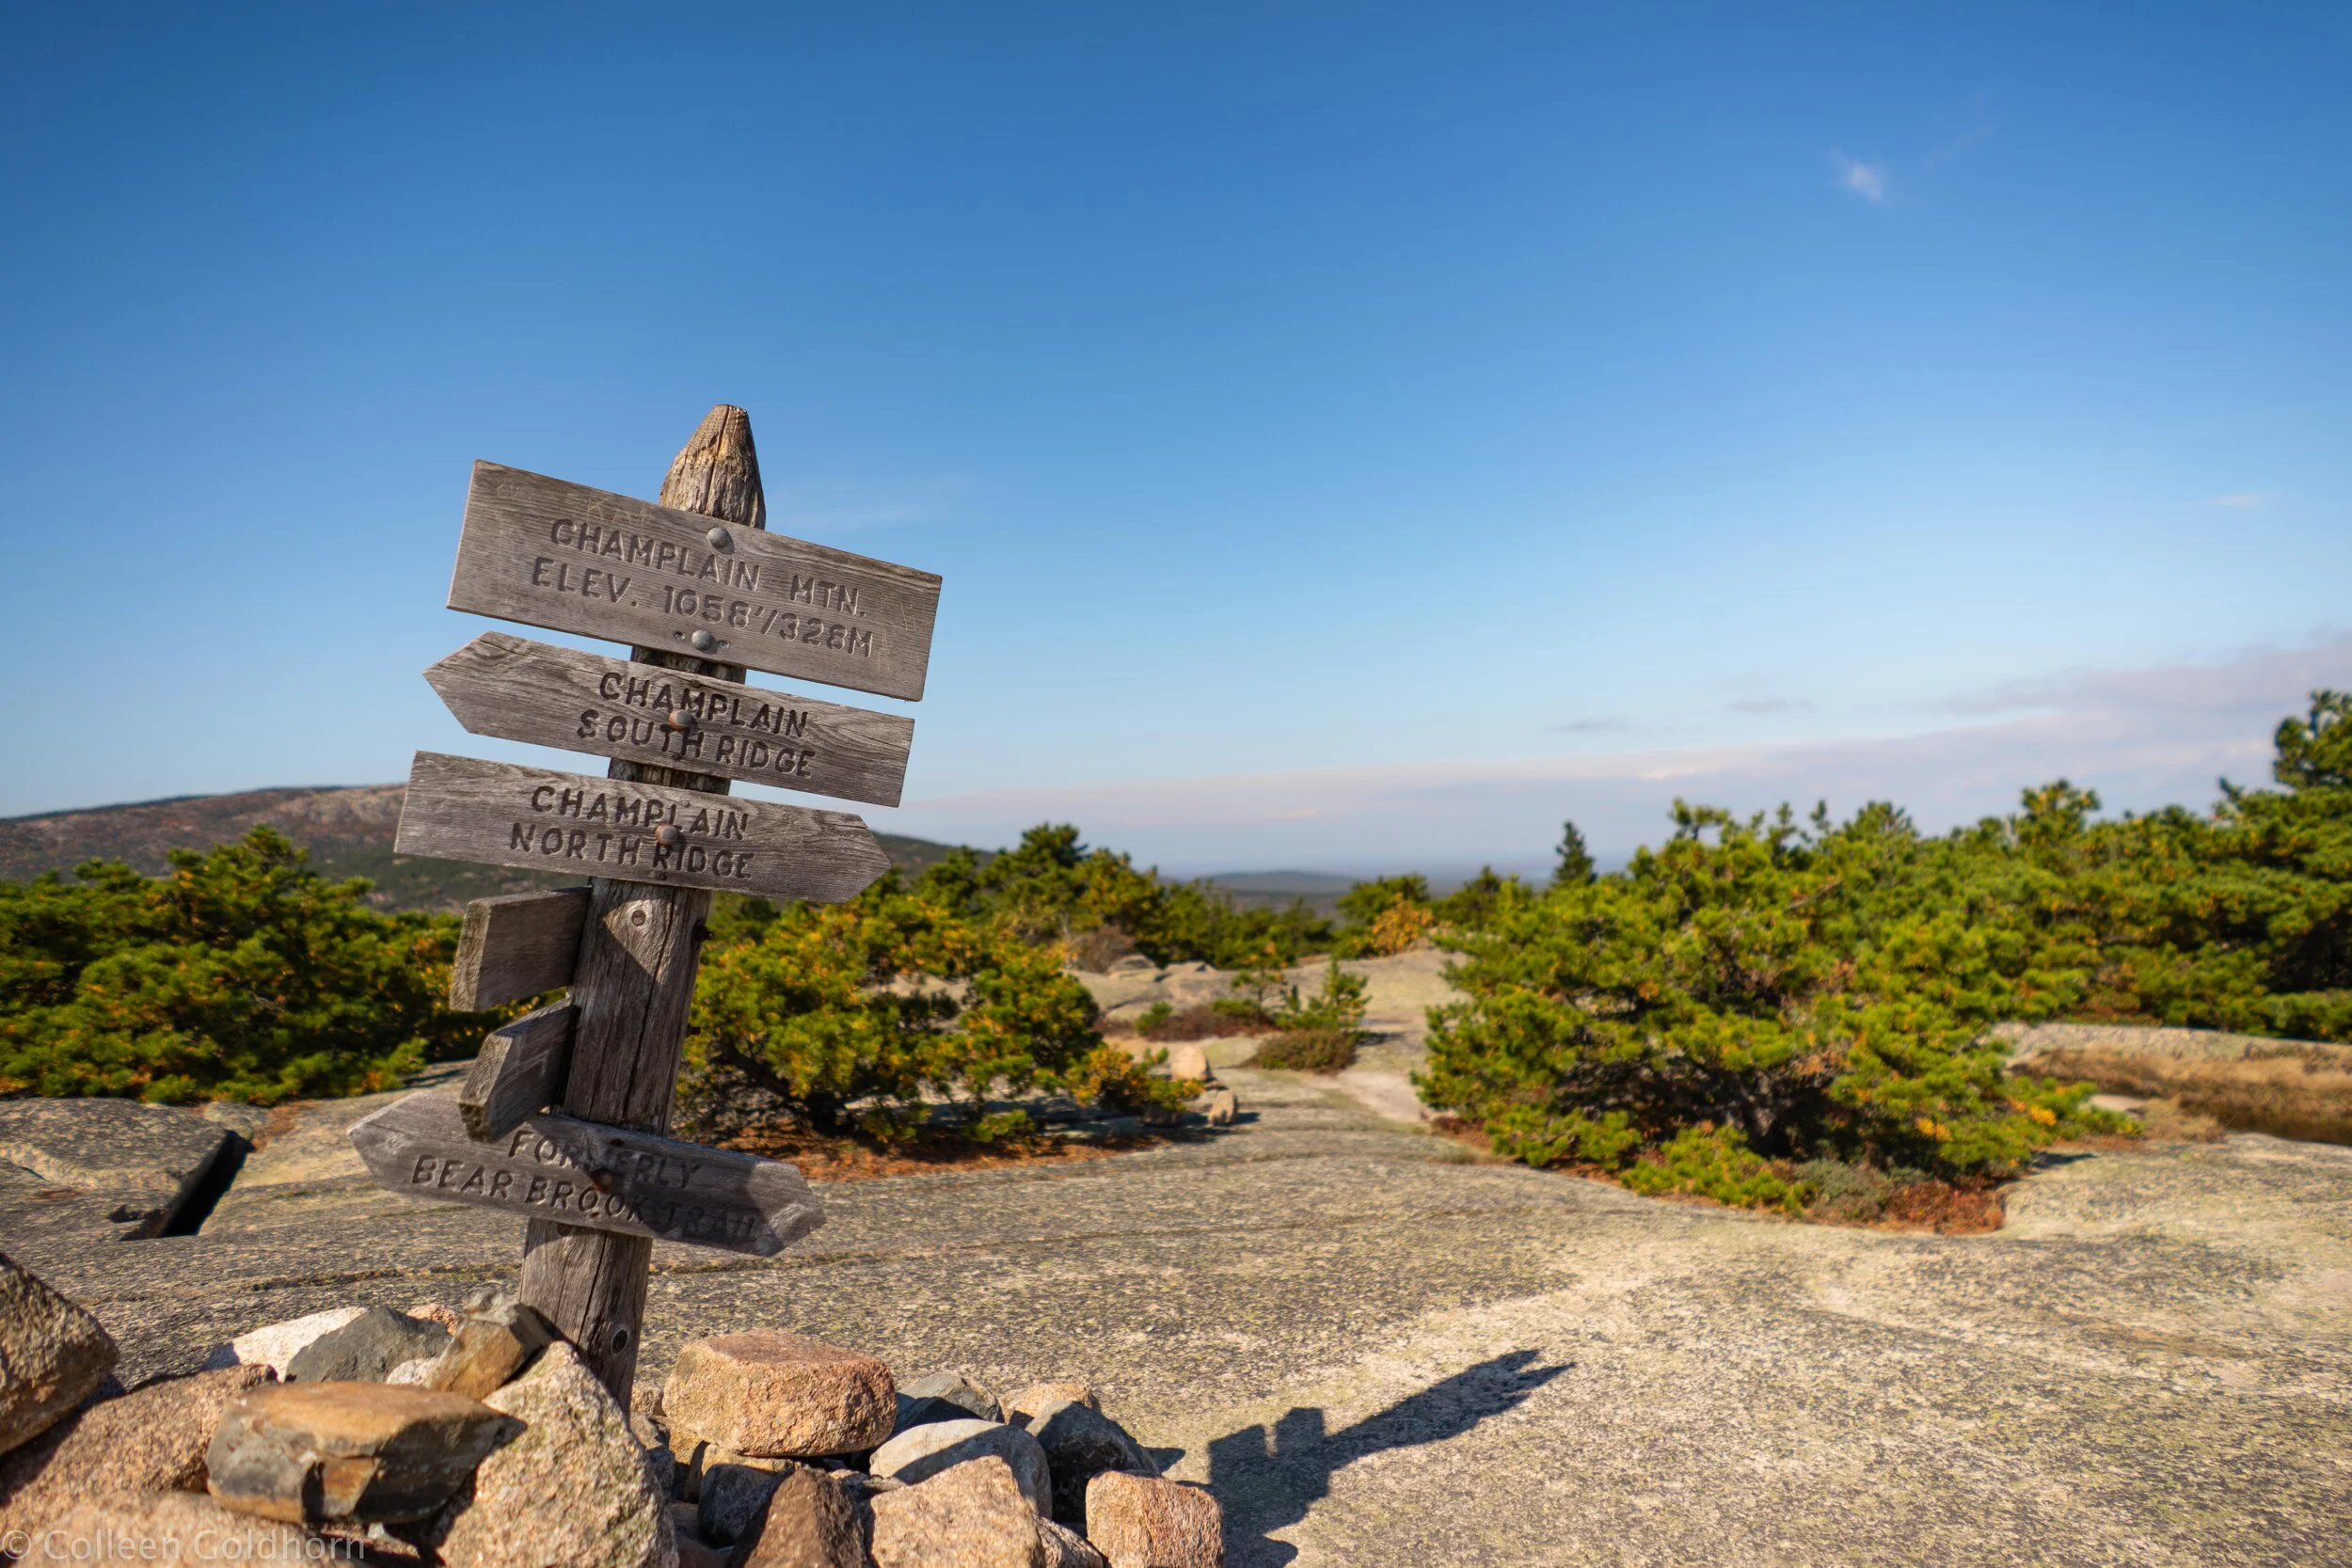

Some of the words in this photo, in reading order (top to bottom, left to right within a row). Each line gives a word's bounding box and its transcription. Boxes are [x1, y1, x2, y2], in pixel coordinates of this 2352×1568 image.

[531, 557, 640, 608] ELEV.
[550, 518, 761, 592] CHAMPLAIN
[789, 575, 866, 617] MTN.
[599, 672, 808, 738] CHAMPLAIN
[576, 709, 705, 757] SOUTH
[715, 736, 817, 779] RIDGE
[532, 785, 749, 841] CHAMPLAIN
[510, 823, 642, 866] NORTH
[653, 839, 755, 879] RIDGE
[411, 1154, 514, 1198] BEAR
[524, 1175, 645, 1224] BROOK
